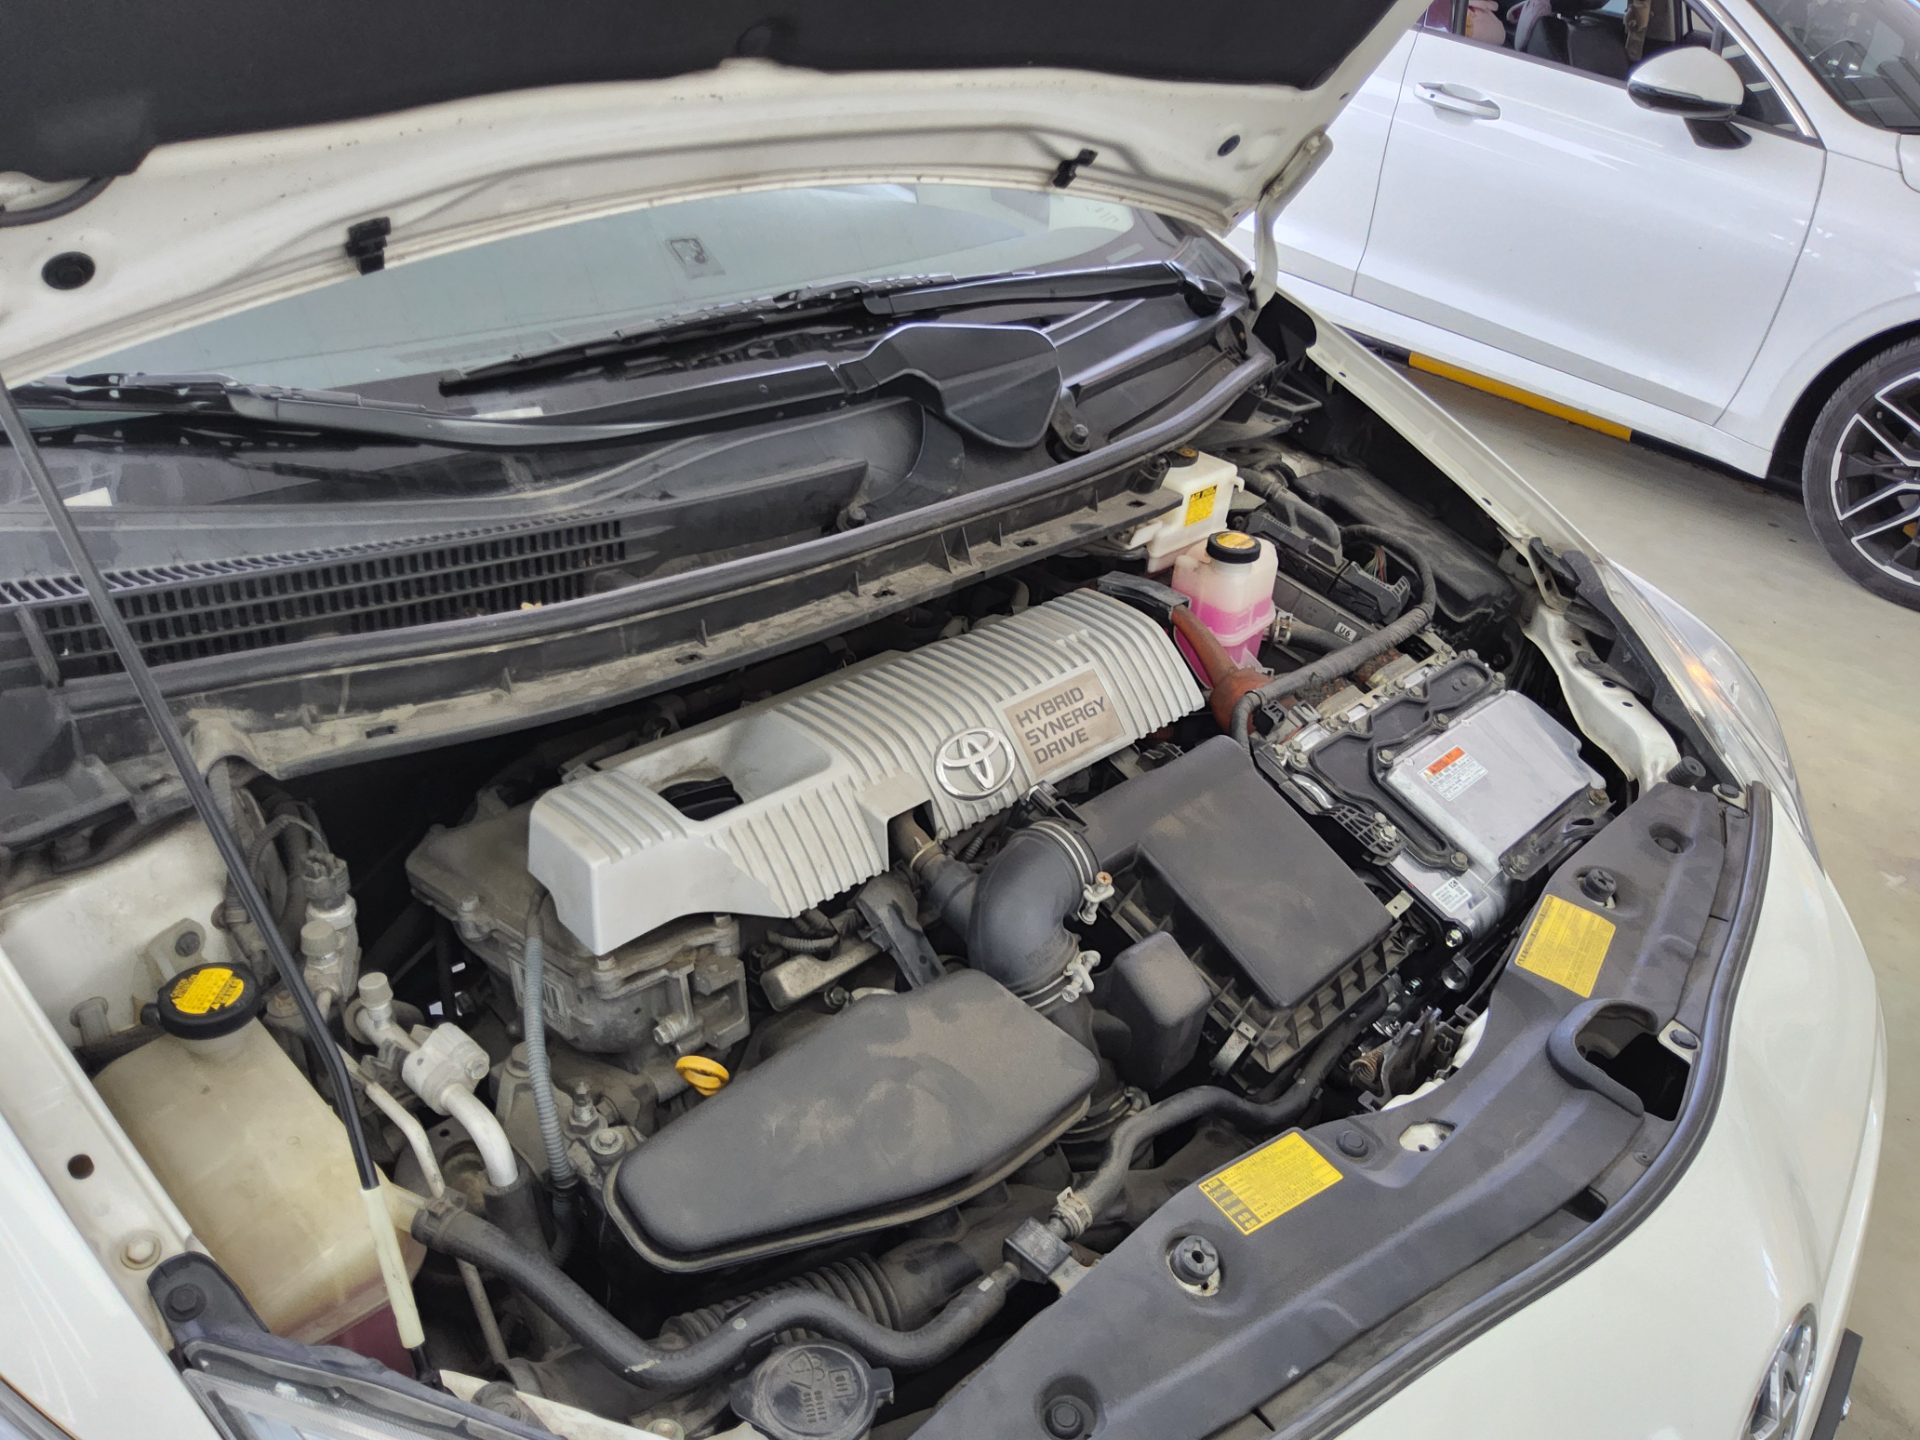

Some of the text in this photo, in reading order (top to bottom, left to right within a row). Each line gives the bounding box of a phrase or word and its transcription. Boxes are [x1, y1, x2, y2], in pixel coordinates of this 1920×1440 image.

[1339, 625, 1352, 637] U6
[1016, 687, 1085, 728] HYBRID
[1025, 696, 1107, 747] SYNERGY
[1034, 727, 1090, 764] DRIVE
